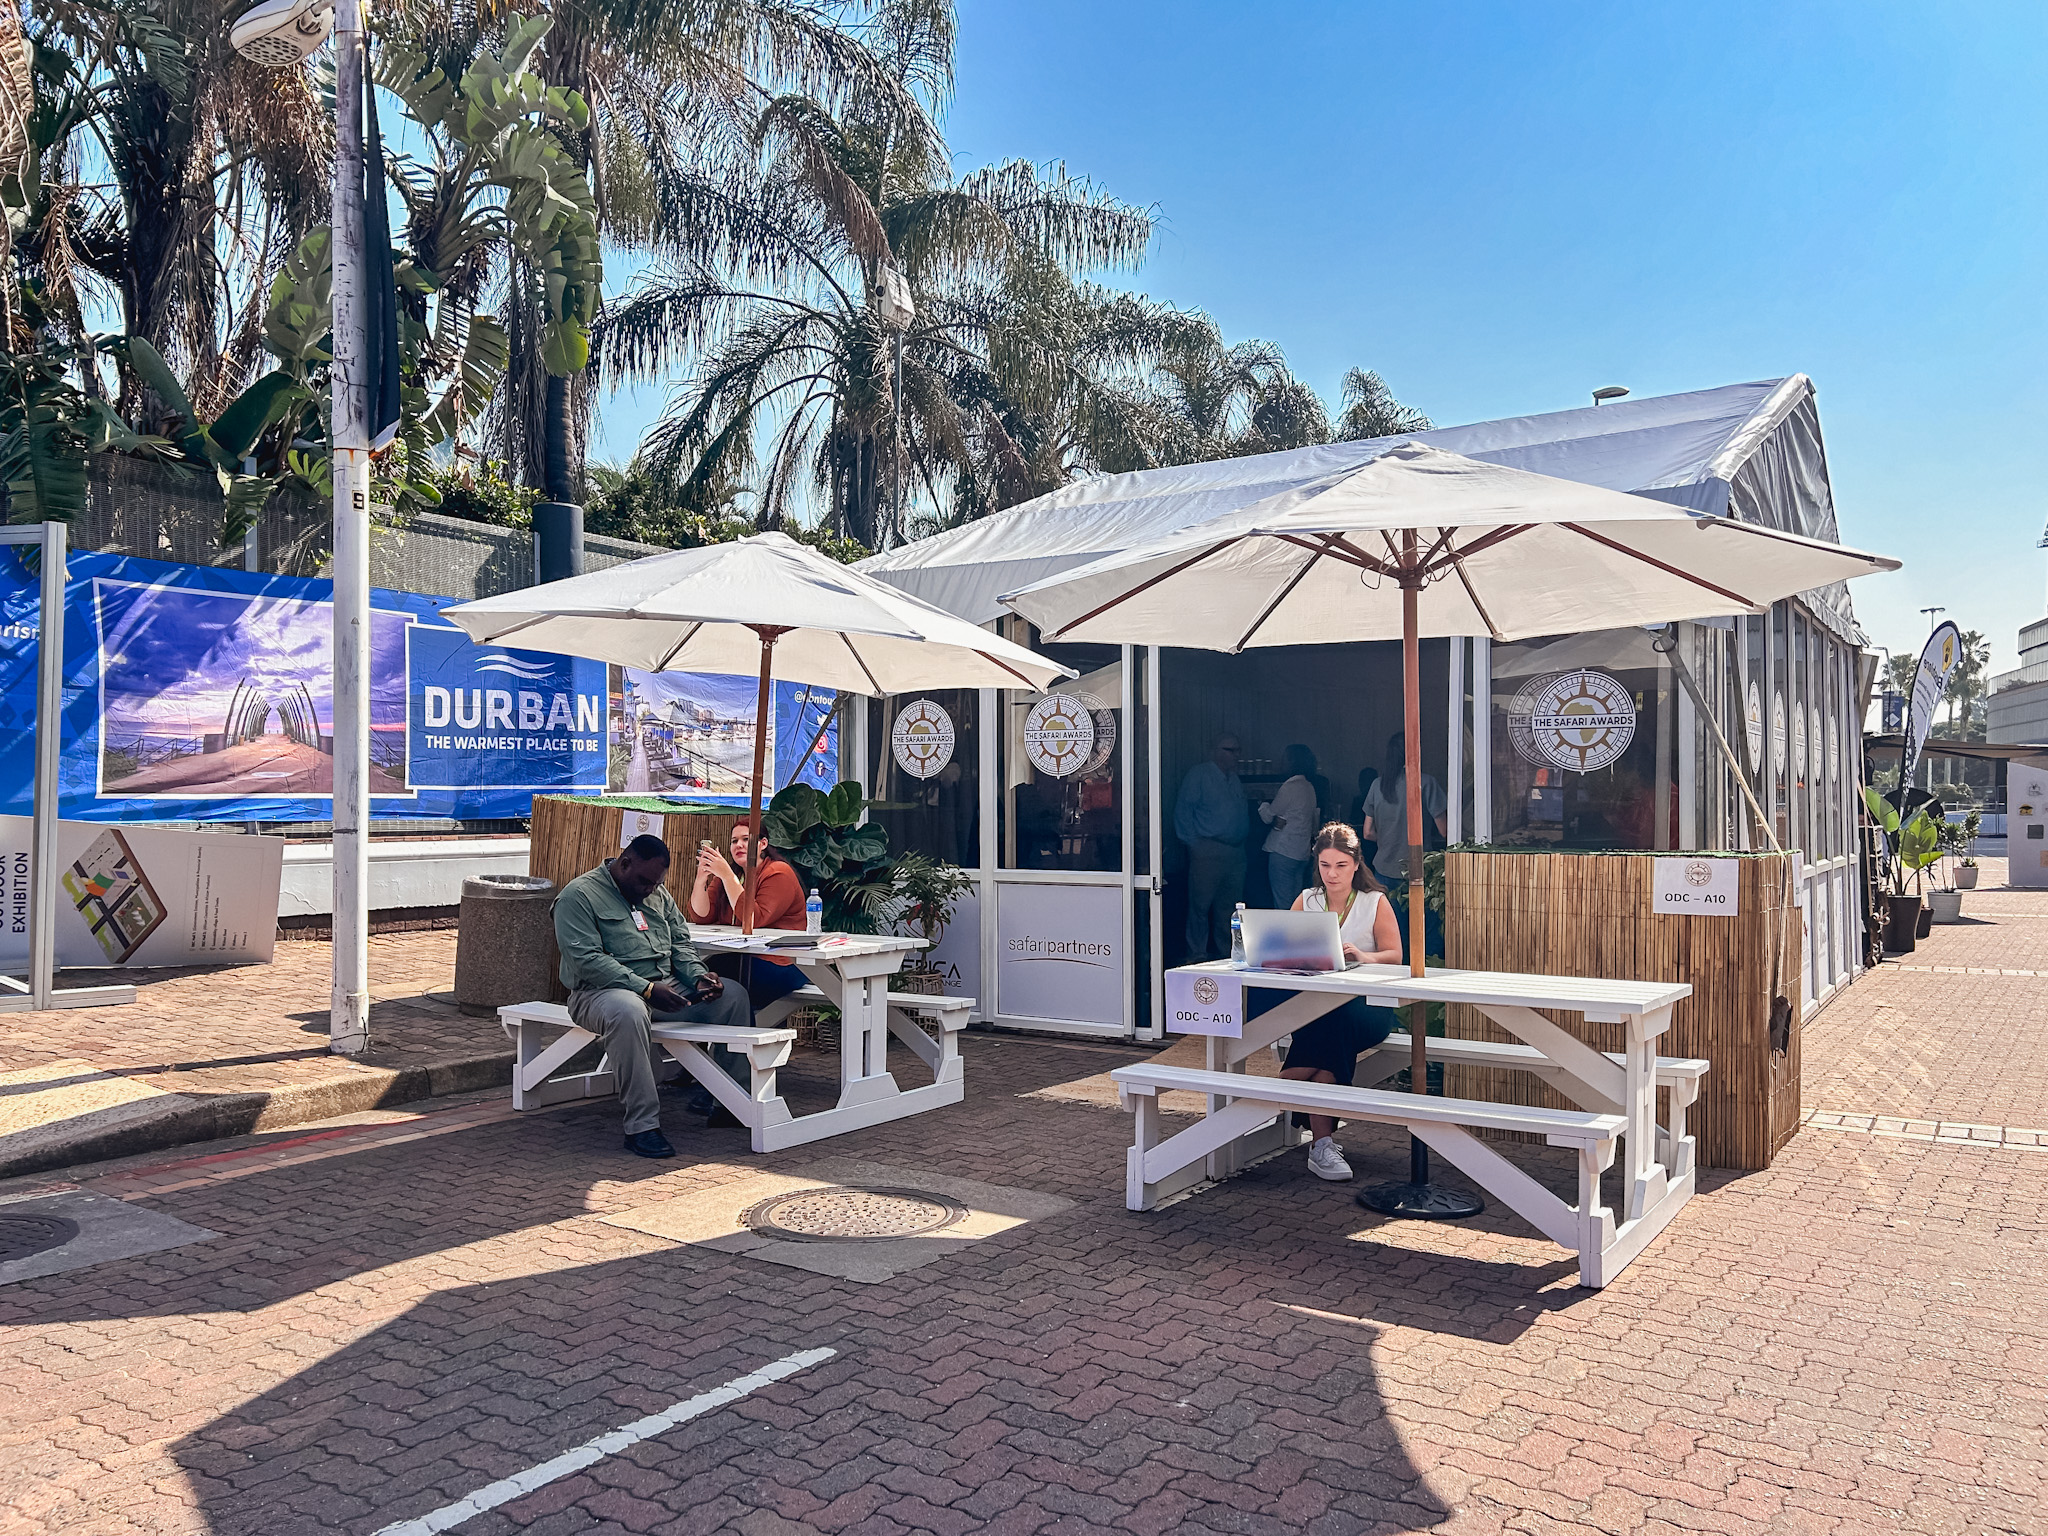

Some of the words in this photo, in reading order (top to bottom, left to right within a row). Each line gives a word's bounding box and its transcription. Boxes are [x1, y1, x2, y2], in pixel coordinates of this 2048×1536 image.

[424, 686, 599, 733] DURBAN
[1534, 718, 1552, 727] THE
[1554, 717, 1587, 727] SAFARI
[1589, 716, 1633, 726] AWARDS
[927, 735, 953, 743] AWARDS
[1026, 732, 1038, 740] THE
[1039, 731, 1061, 740] SAFARI
[1063, 731, 1092, 739] AWARDS
[1094, 728, 1114, 736] ARDS
[425, 735, 451, 749] THE
[454, 736, 523, 750] WARMEST
[526, 738, 567, 751] PLACE
[570, 739, 584, 751] TO
[586, 739, 598, 752] BE
[12, 852, 28, 933] EXHIBITION
[1664, 893, 1690, 902] ODC
[1704, 894, 1726, 904] A10
[1008, 935, 1112, 956] safaripartners
[900, 959, 962, 979] FRICA
[1176, 1010, 1200, 1021] ODC
[1212, 1013, 1232, 1024] A10
